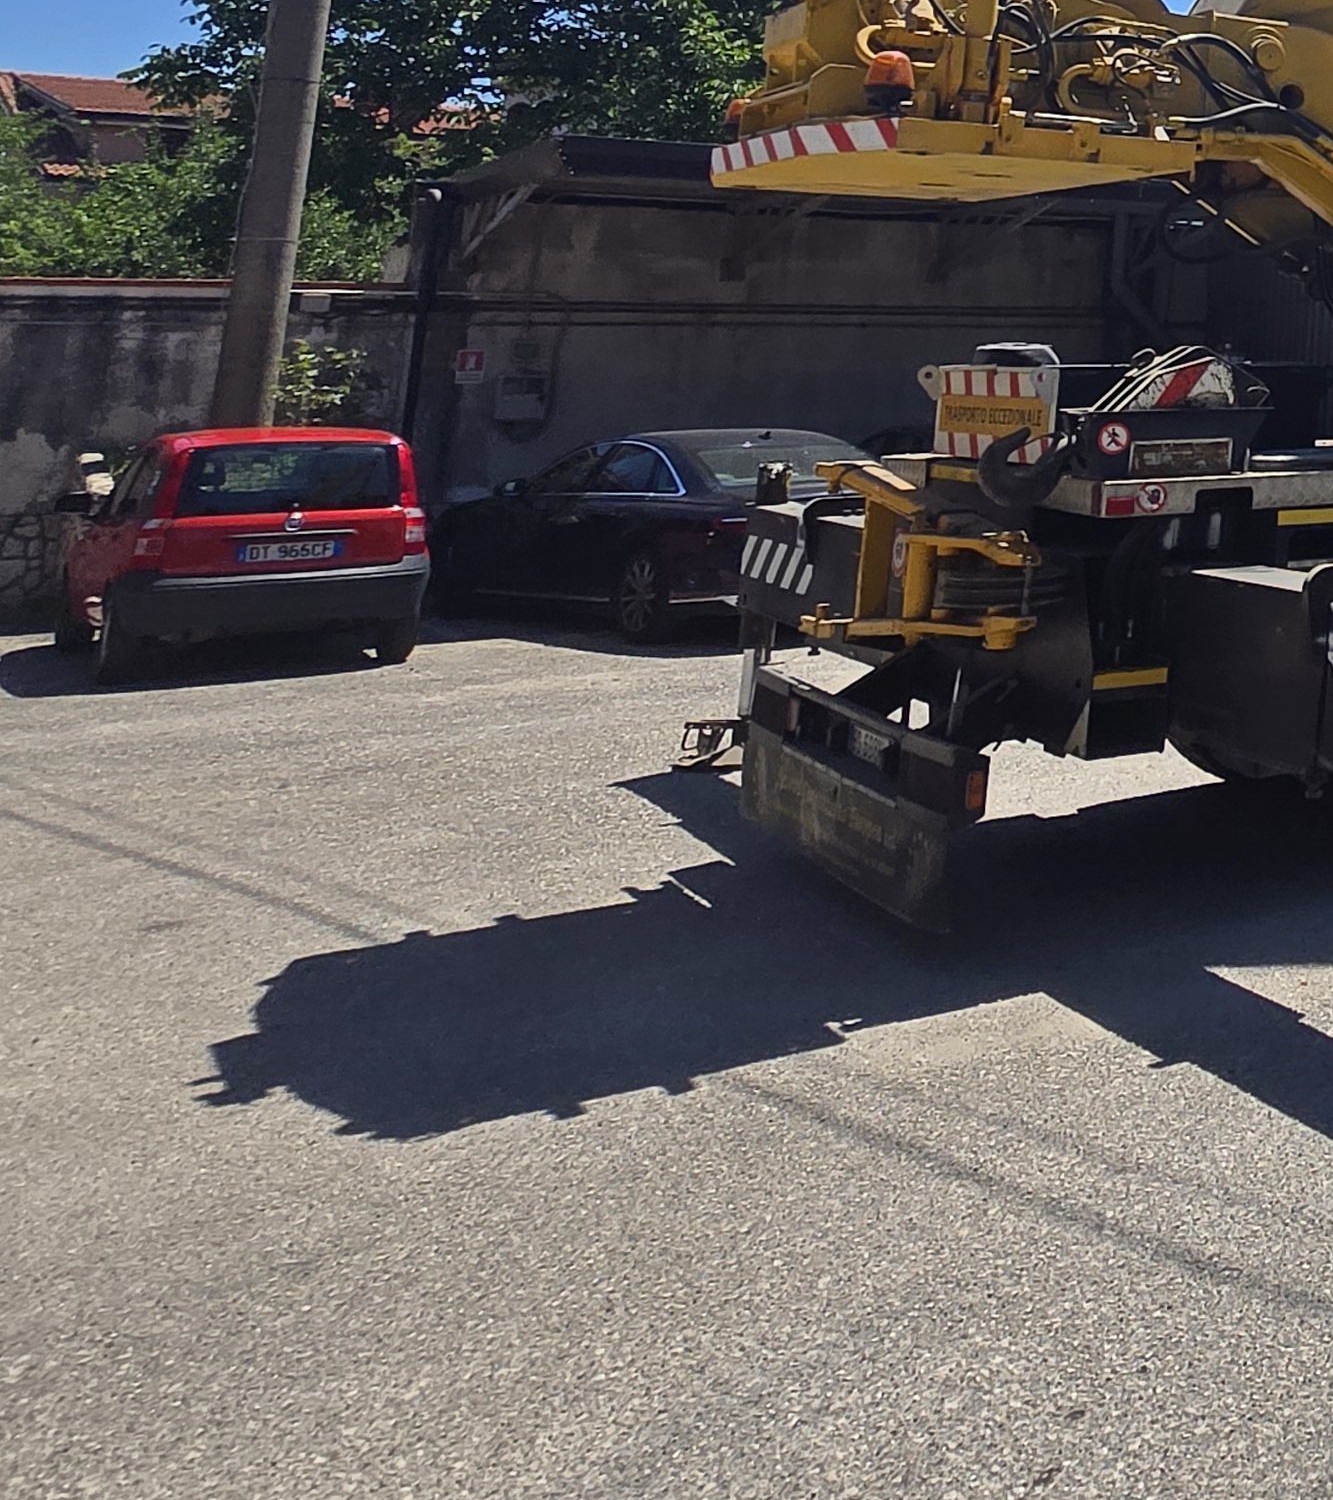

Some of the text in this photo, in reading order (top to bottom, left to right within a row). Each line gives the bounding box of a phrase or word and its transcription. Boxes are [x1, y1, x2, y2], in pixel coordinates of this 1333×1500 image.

[945, 405, 1043, 427] TRASPORTO ECCEZIONALE
[249, 545, 271, 560] DT
